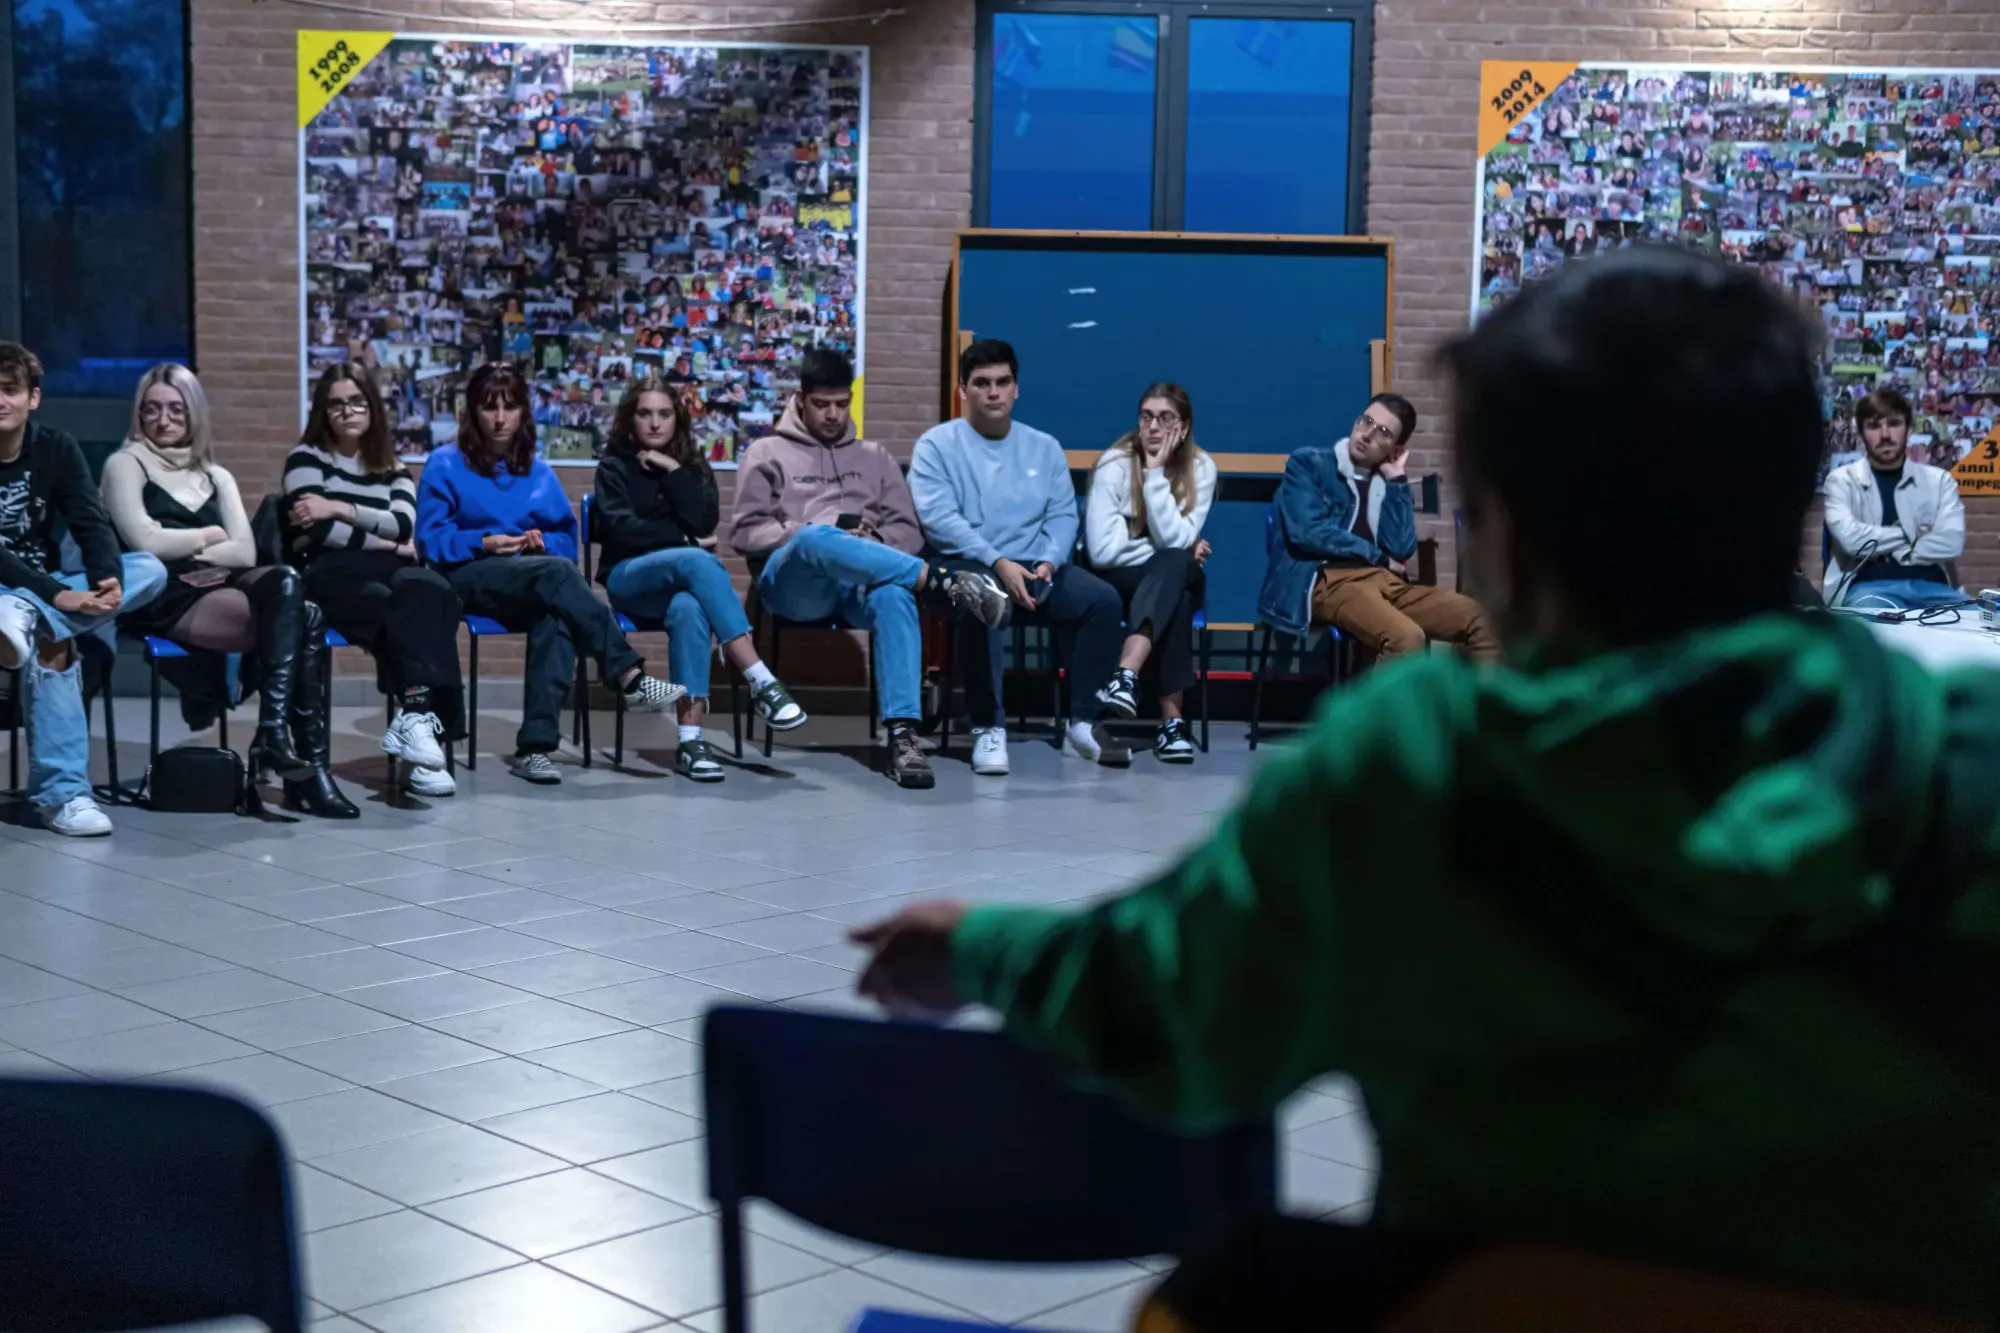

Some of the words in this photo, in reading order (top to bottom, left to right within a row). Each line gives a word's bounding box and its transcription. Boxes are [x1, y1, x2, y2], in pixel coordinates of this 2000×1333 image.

[309, 40, 349, 80] 1999
[321, 52, 360, 92] 2008
[1492, 70, 1532, 111] 2009
[1503, 81, 1546, 123] 2014
[1957, 461, 1994, 473] anni
